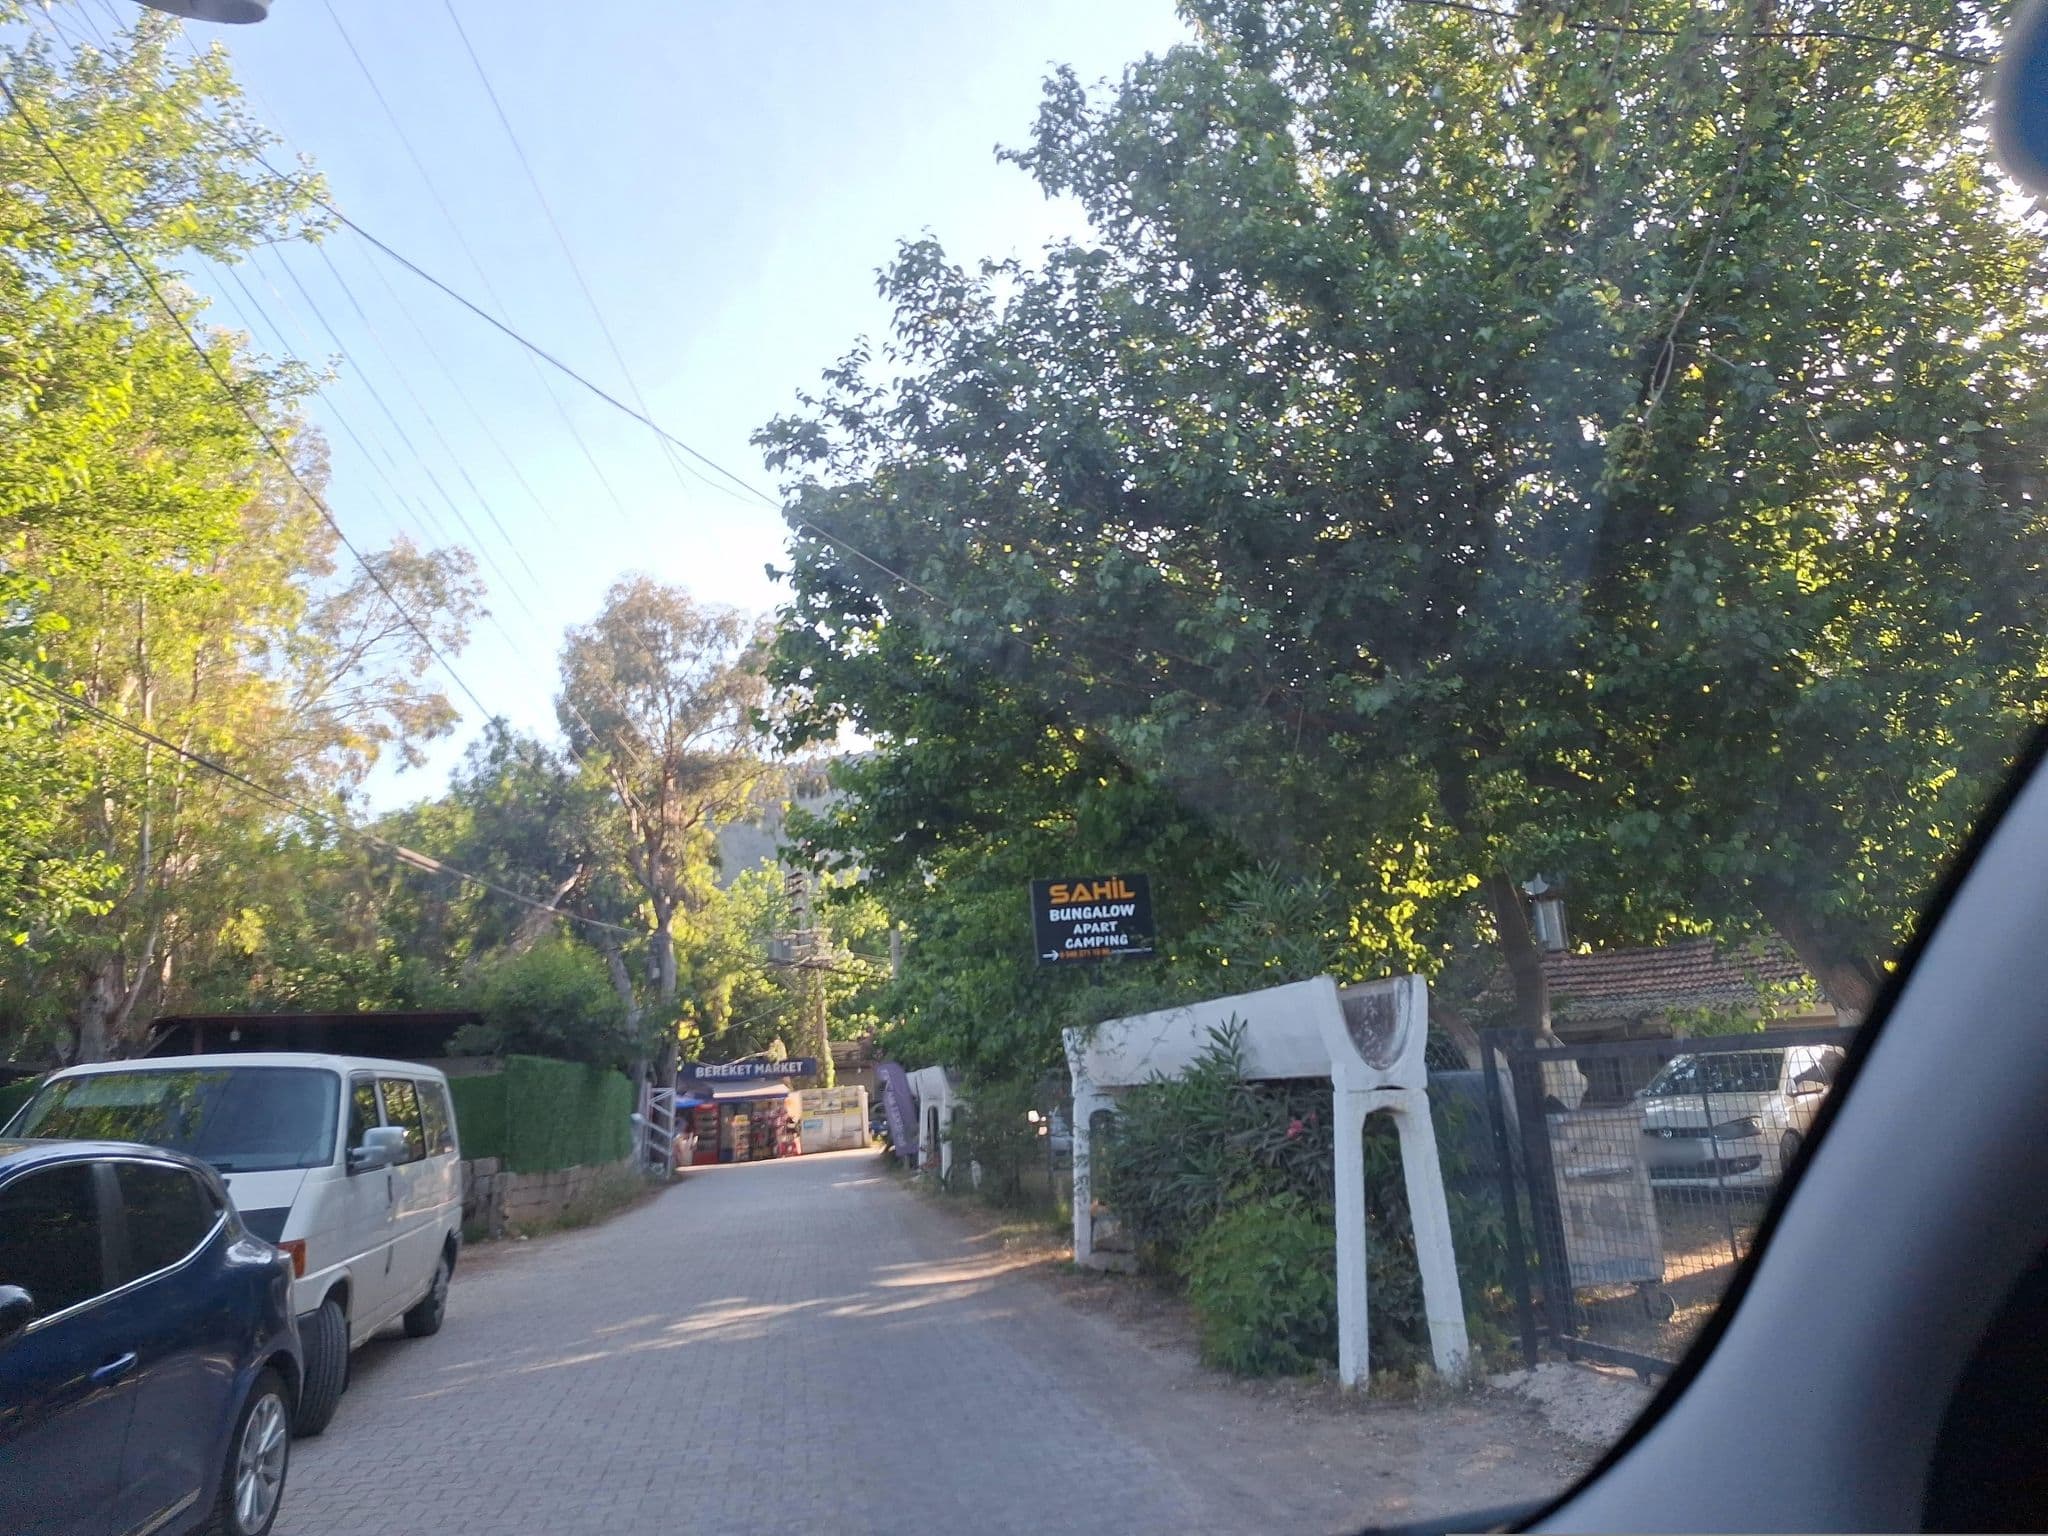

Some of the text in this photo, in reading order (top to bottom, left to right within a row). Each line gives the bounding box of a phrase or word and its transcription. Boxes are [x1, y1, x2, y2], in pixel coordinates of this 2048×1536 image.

[1049, 904, 1135, 922] BUNGALOW
[1073, 921, 1118, 935] APART
[1065, 934, 1128, 949] CAMPING
[695, 1061, 804, 1078] BEREKET MARKET
